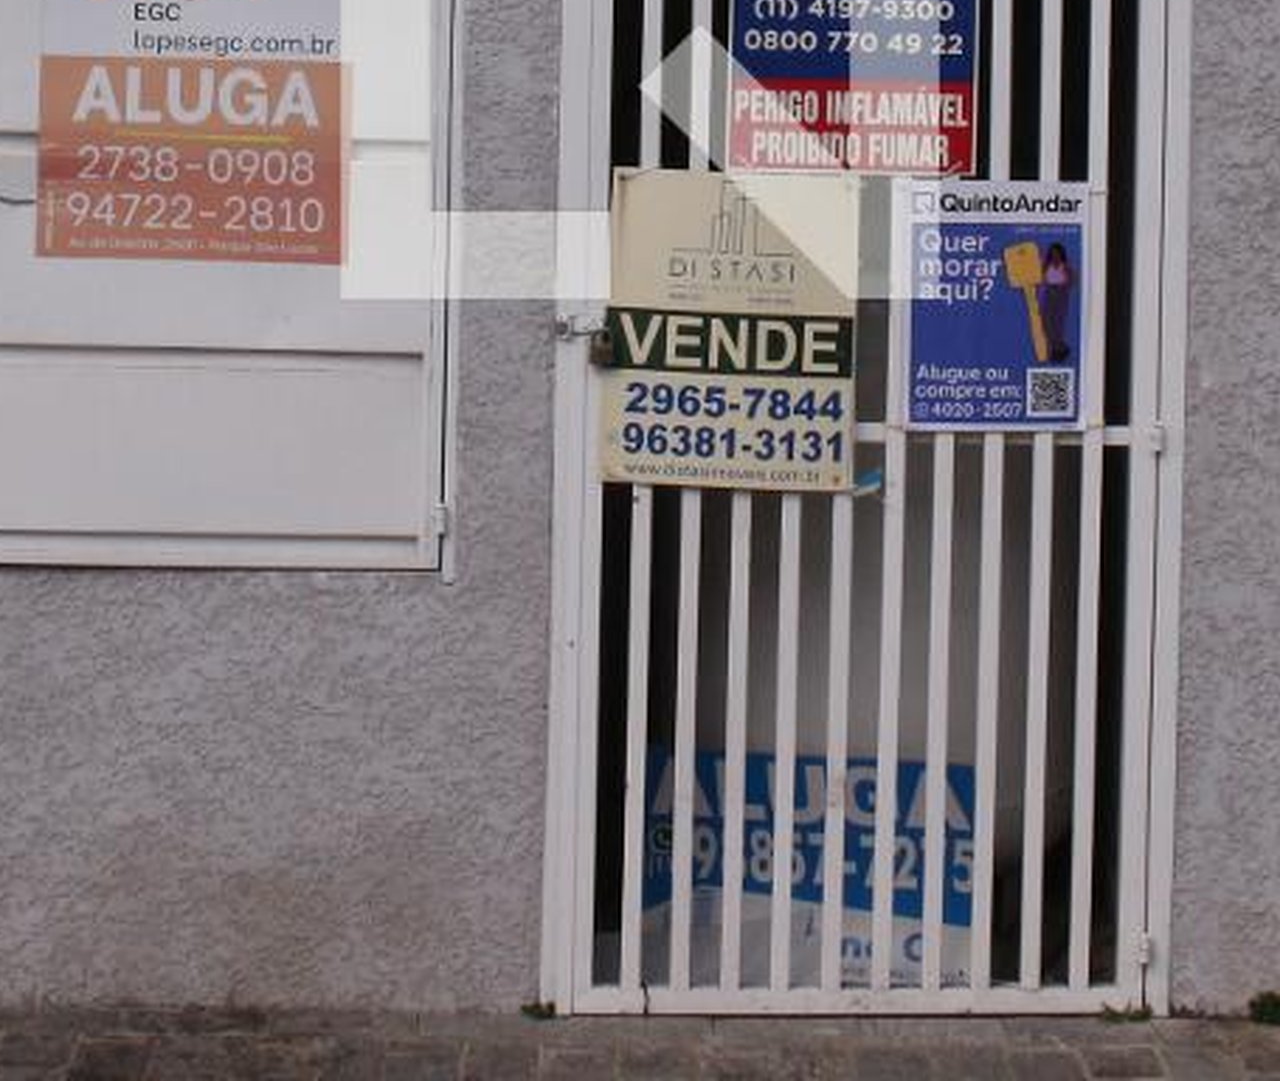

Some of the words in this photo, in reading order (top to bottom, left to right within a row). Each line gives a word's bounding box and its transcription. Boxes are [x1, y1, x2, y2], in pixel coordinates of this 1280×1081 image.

[134, 2, 182, 21] EGC
[132, 30, 335, 58] lopesegc.com.br
[744, 30, 818, 52] 0800
[828, 32, 879, 53] 770
[887, 34, 923, 54] 49
[930, 34, 964, 56] 22
[72, 64, 319, 128] ALUGA
[735, 89, 820, 125] PERIGO
[826, 85, 969, 128] INFLAMÁVEL
[751, 130, 862, 169] PROIBIDO
[868, 133, 950, 170] FUMAR
[76, 144, 316, 186] 2738-0908
[69, 191, 325, 233] 94722-2810
[939, 192, 1082, 214] QuintoAndar
[920, 229, 990, 253] Quer
[920, 255, 1002, 277] morar
[920, 277, 995, 305] aqui?
[621, 312, 840, 374] VENDE
[916, 364, 982, 384] Alugue
[985, 367, 1009, 380] ou
[624, 382, 845, 421] 2965-7844
[914, 385, 987, 401] compre
[623, 421, 844, 463] 96381-3131
